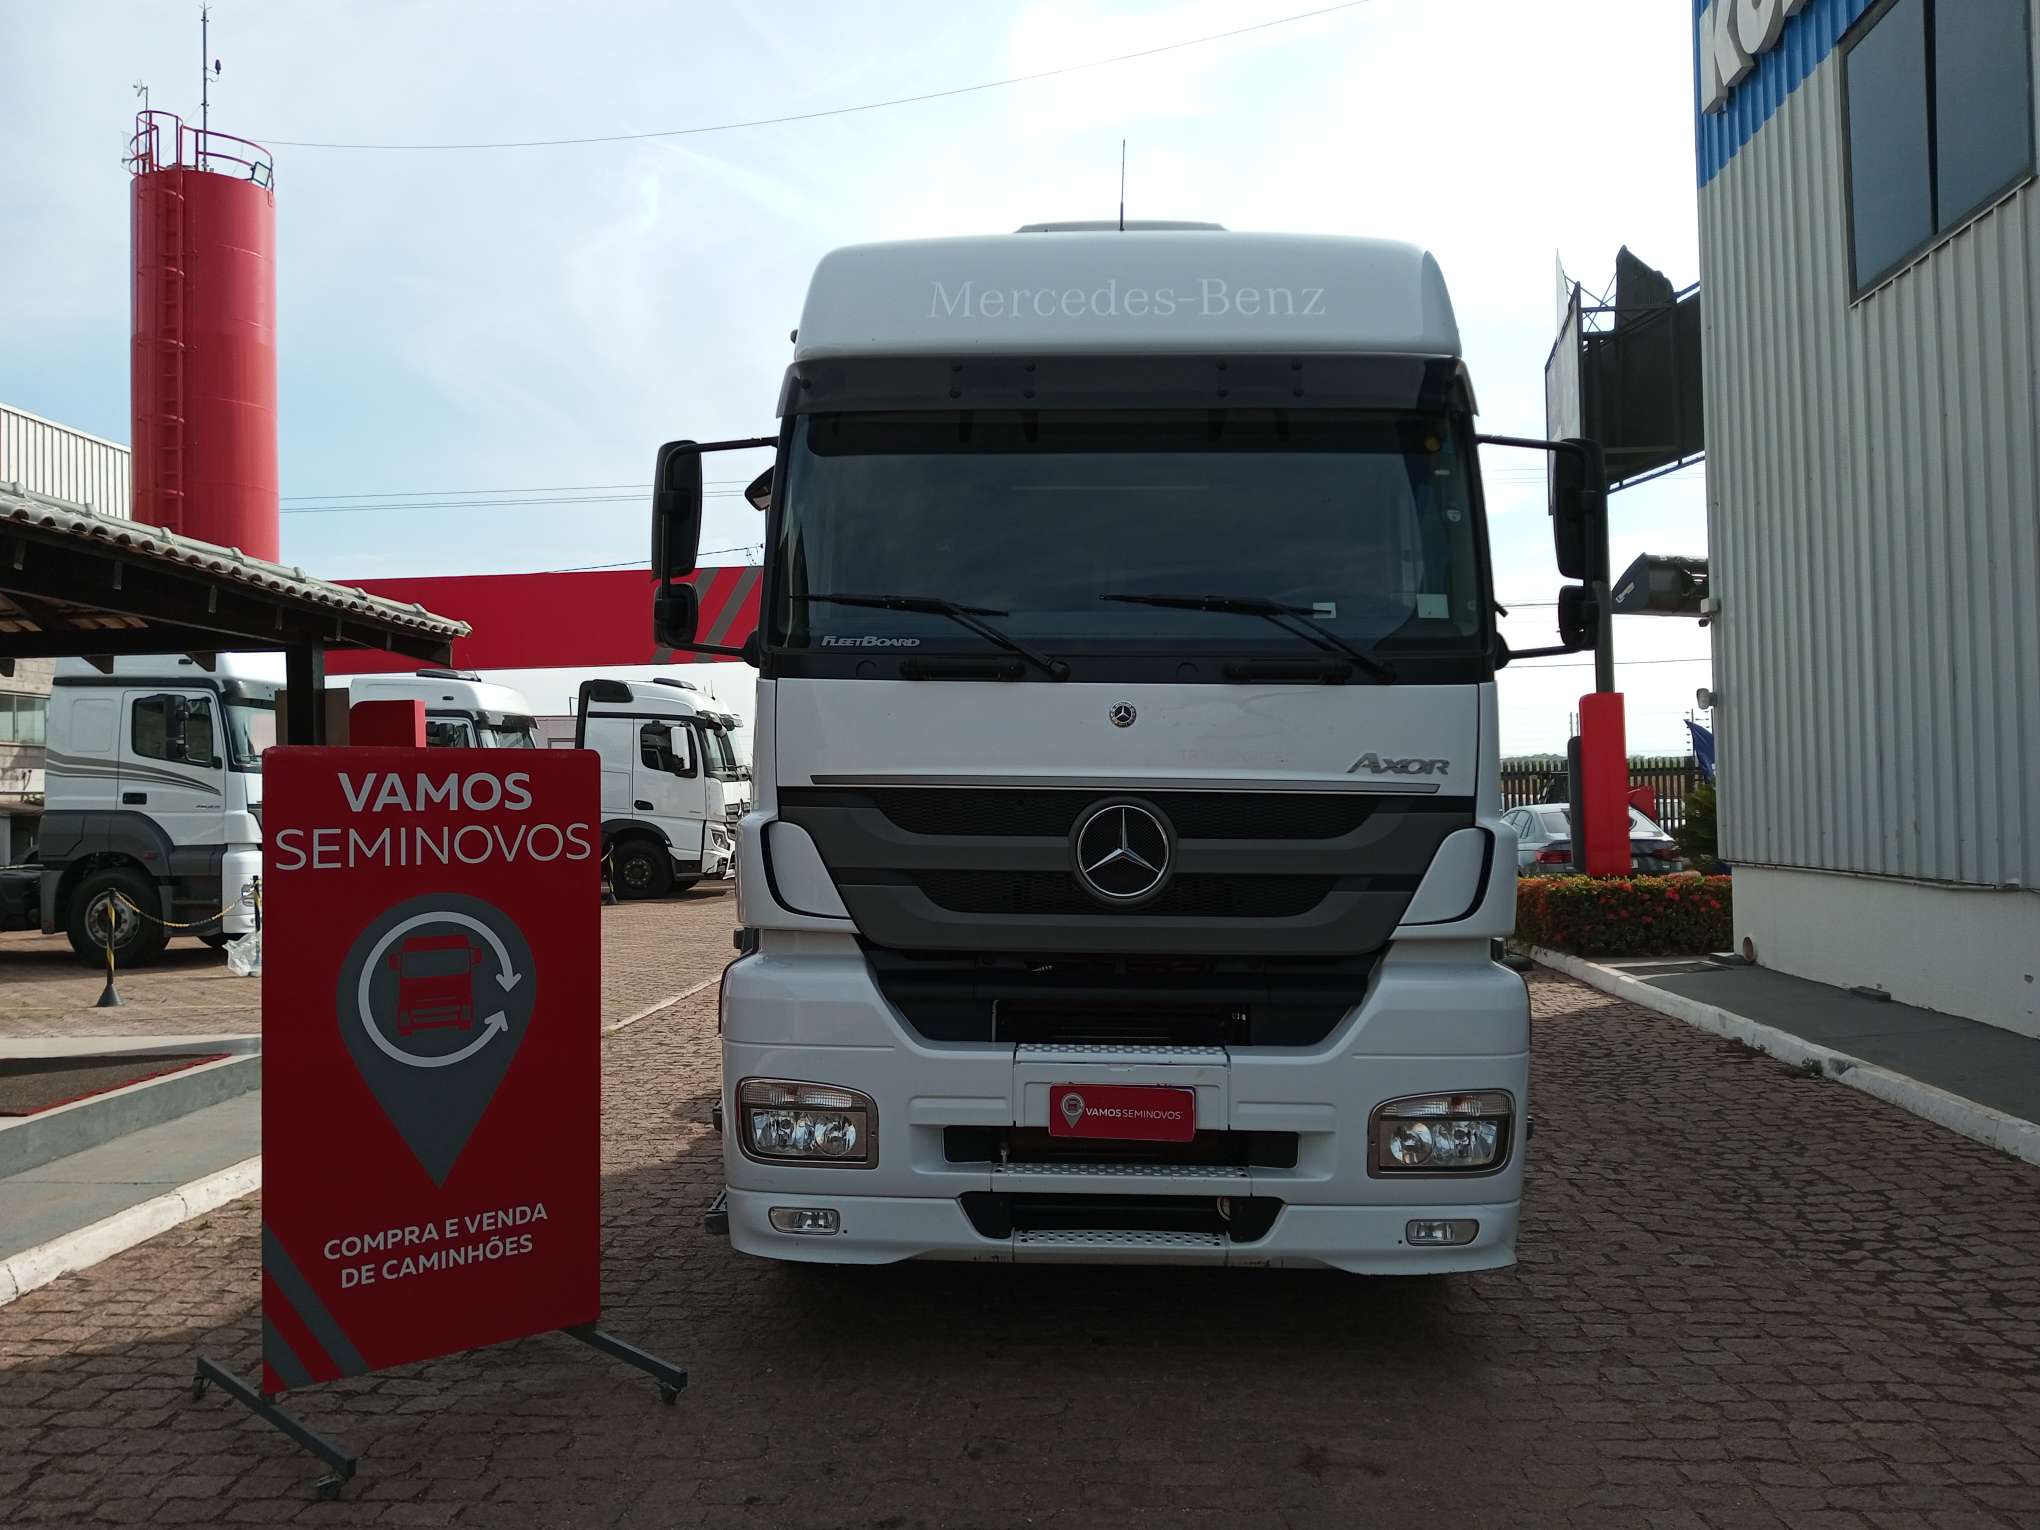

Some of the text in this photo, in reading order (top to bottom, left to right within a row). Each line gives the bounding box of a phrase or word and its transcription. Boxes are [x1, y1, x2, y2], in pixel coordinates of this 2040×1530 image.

[927, 277, 1328, 318] Mercedes-Benz
[1346, 752, 1450, 775] AXOR
[337, 772, 533, 812] VAMOS
[275, 823, 592, 871] SEMINOVOS
[1085, 1107, 1122, 1118] VAMOS
[323, 1202, 548, 1260] COMPRA E VENDA
[341, 1234, 533, 1289] DE CAMINHÕES
